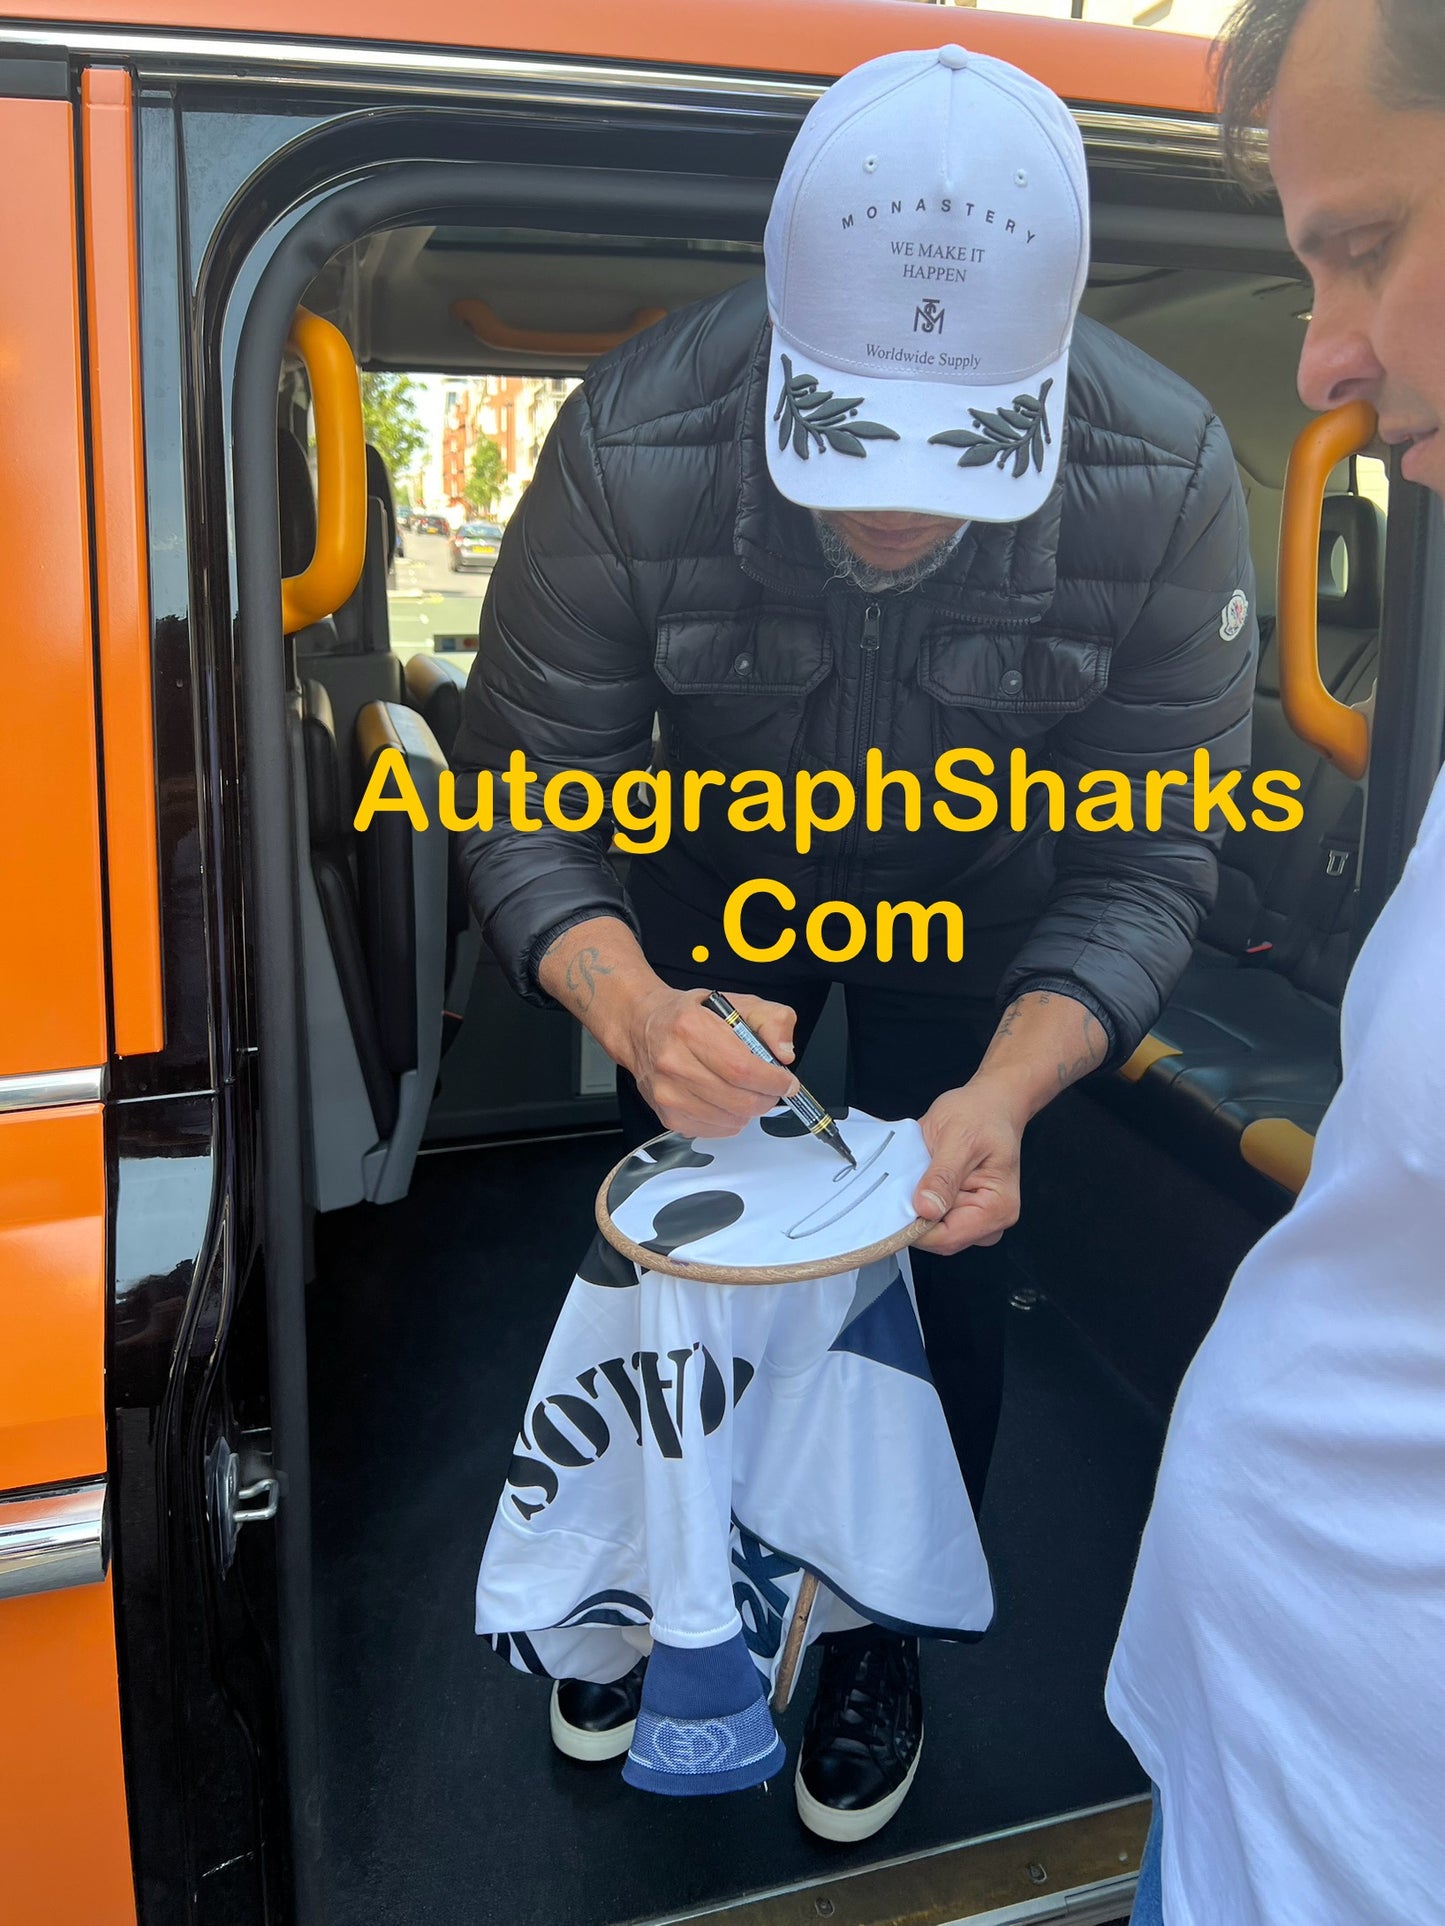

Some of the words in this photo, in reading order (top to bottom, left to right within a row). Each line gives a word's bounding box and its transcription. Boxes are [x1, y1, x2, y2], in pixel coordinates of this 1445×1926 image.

[842, 199, 1036, 244] MONASTERY
[891, 241, 914, 257] WE
[918, 243, 967, 262] MAKE
[970, 248, 986, 264] IT
[902, 264, 968, 283] HAPPEN
[866, 343, 935, 366] Worldwide
[938, 352, 982, 371] Supply
